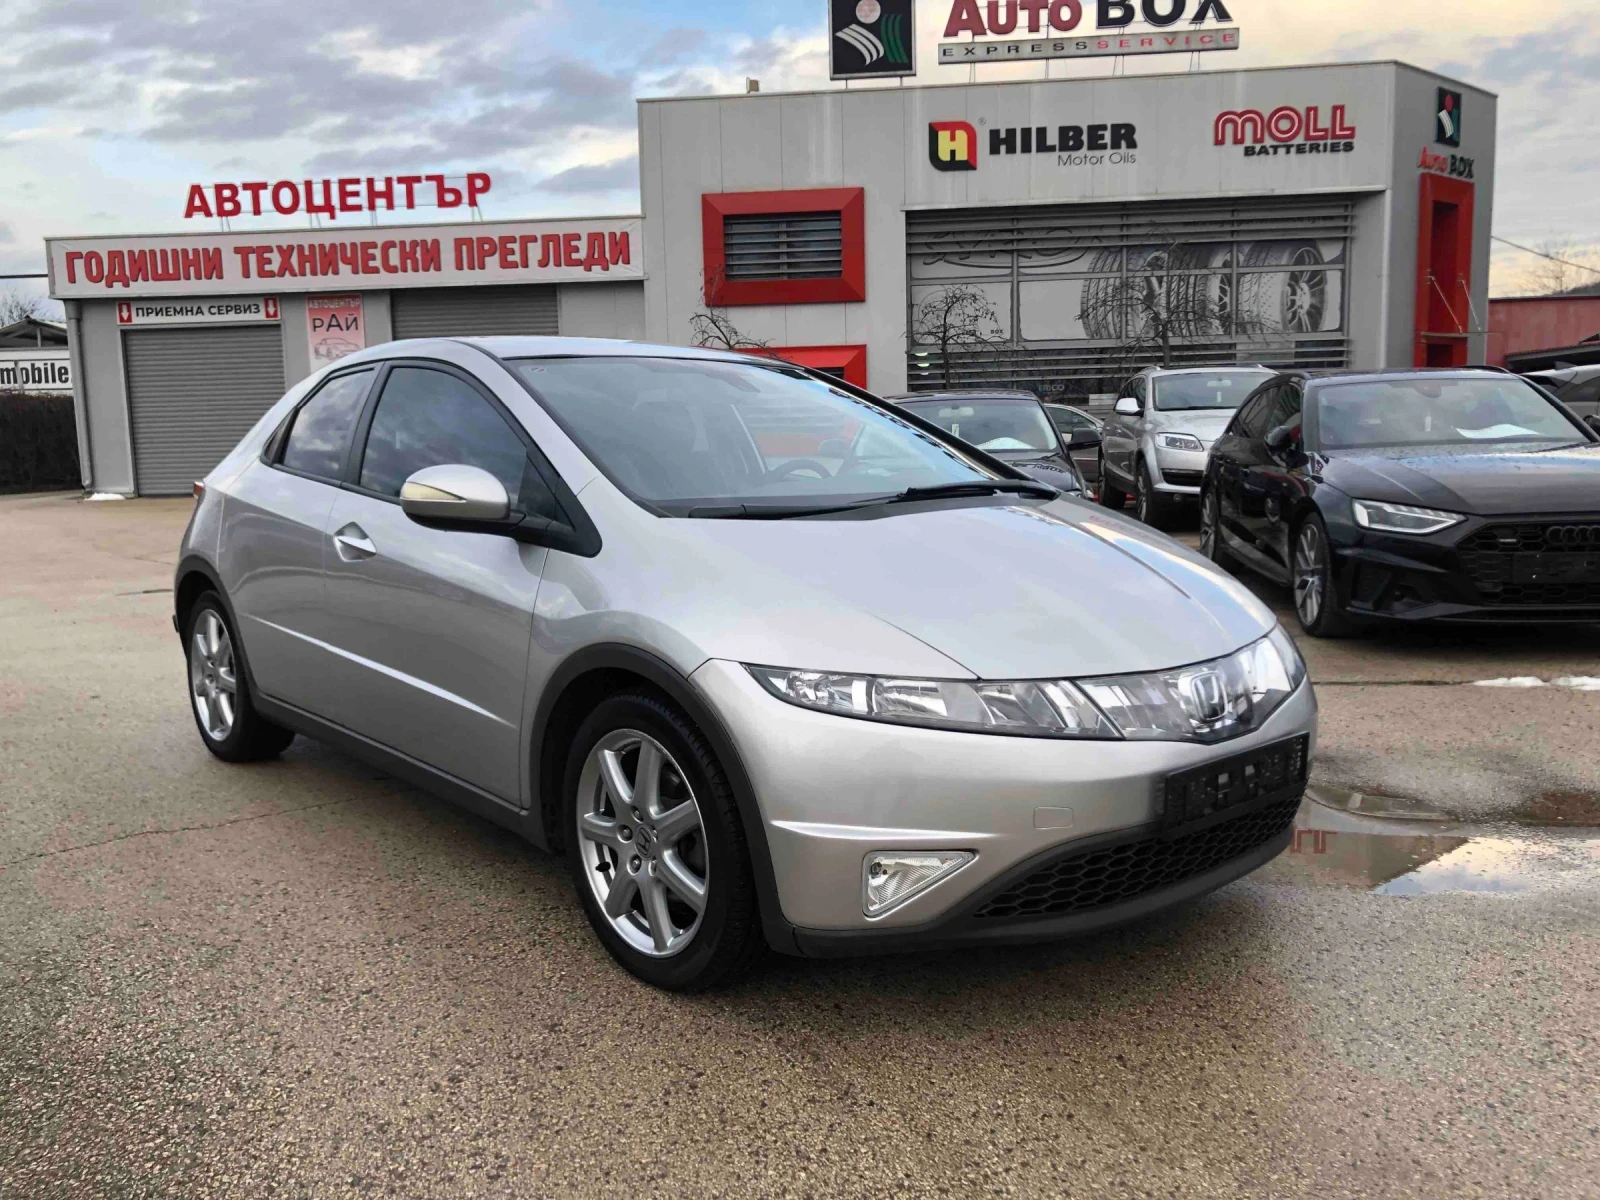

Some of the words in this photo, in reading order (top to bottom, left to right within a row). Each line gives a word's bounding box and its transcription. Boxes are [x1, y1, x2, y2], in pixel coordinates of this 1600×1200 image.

[1096, 0, 1233, 29] BOX
[989, 123, 1138, 155] HILBER
[1243, 141, 1355, 156] BATTERIES
[1057, 153, 1105, 167] Motor
[1108, 151, 1137, 165] Oils
[184, 172, 491, 220] АВТОЦЕНТЪР
[65, 247, 224, 288] ГОДИШНИ
[233, 239, 441, 279] ТЕХНИЧЕСКИ
[454, 231, 630, 271] ПРЕГЛЕДИ
[135, 303, 204, 317] ПРИЕМНА
[208, 303, 261, 316] СЕРВИЗ
